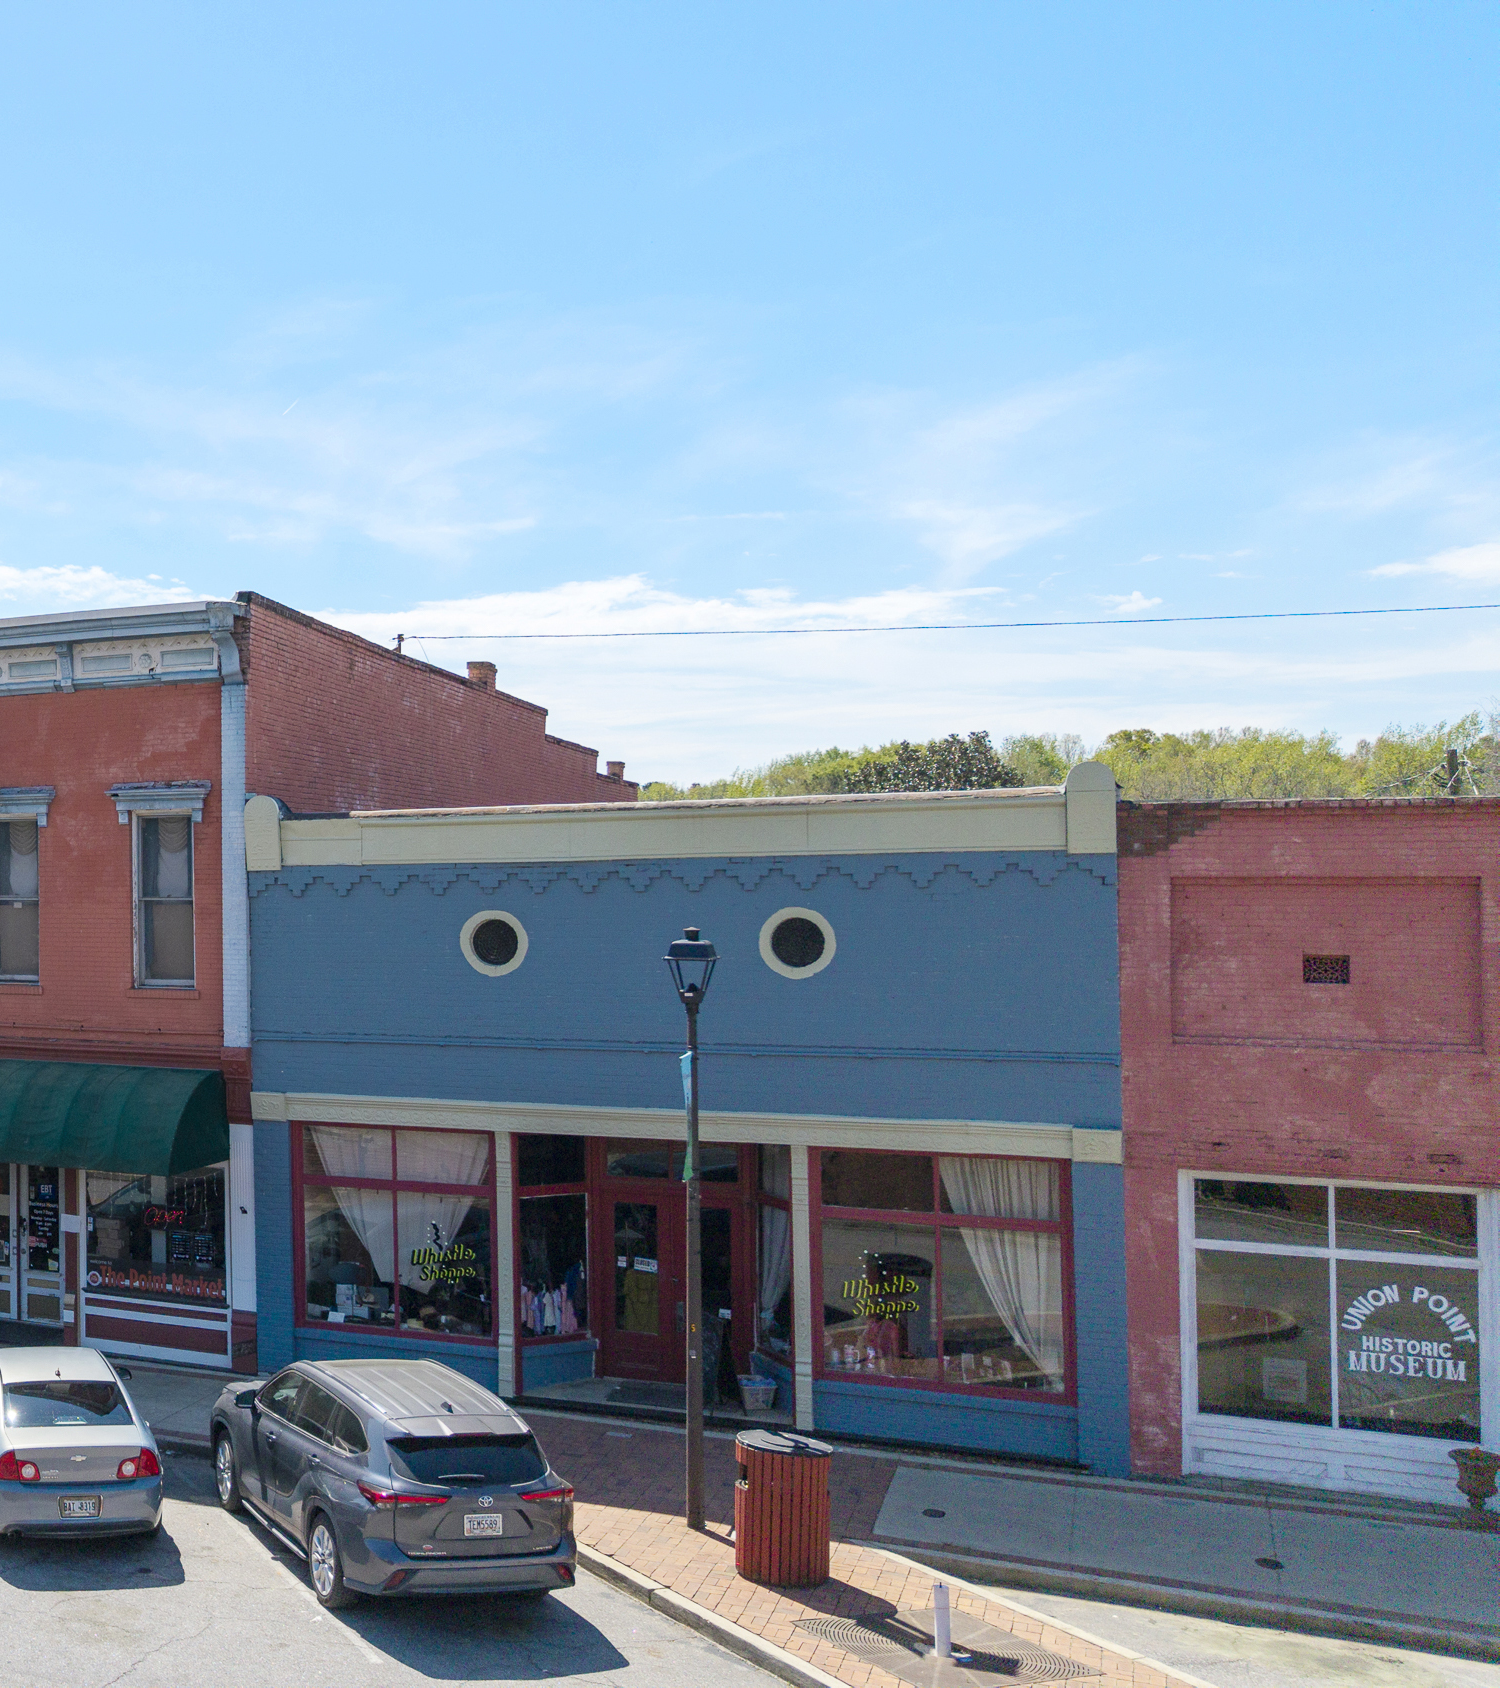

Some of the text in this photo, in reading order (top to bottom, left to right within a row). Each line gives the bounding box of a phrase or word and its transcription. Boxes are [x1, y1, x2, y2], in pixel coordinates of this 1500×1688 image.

[40, 1184, 53, 1193] EBT
[100, 1264, 224, 1299] The Point Market
[420, 1265, 476, 1284] Shoppe
[852, 1298, 919, 1319] Shoppe
[1341, 1284, 1477, 1343] UNION POINT
[1362, 1335, 1452, 1358] HISTORIC
[1348, 1350, 1467, 1381] MUSEUM
